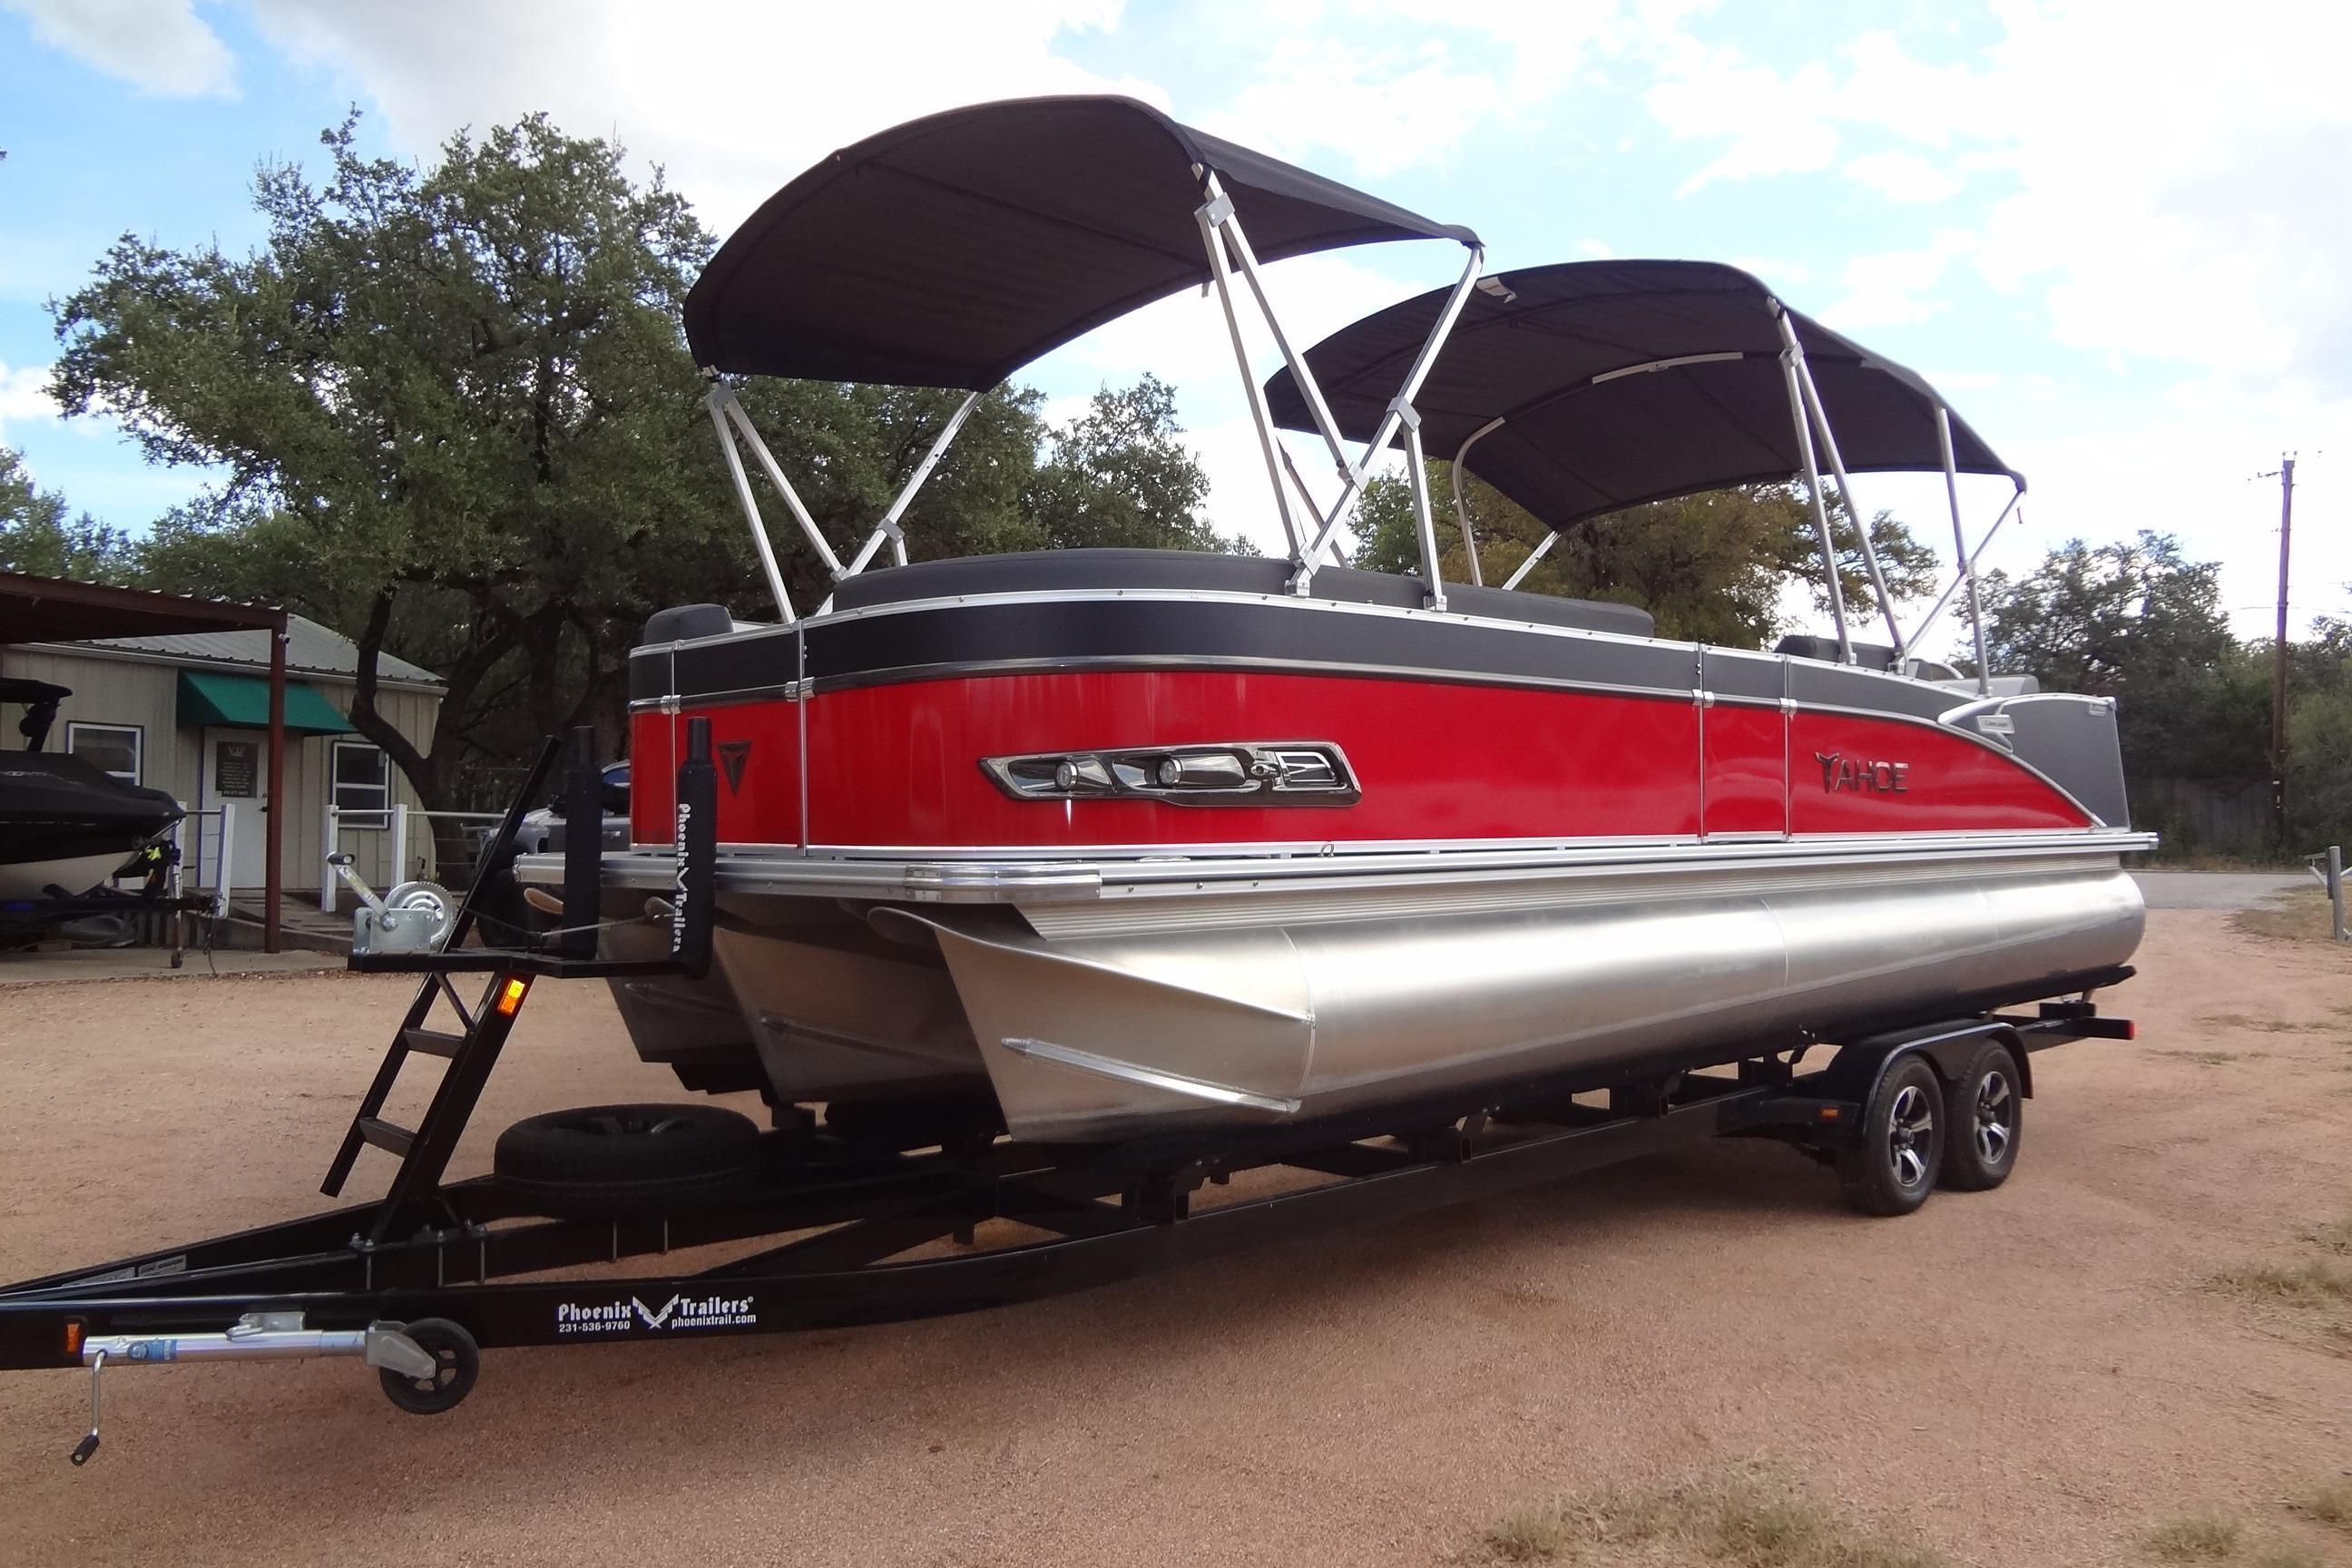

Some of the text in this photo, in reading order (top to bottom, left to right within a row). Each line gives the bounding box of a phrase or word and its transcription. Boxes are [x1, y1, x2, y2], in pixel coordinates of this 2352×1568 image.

[672, 803, 691, 953] Phoenix Trailers
[558, 1301, 632, 1321] Phoenix
[559, 1321, 631, 1333] 231-536-9760
[671, 1314, 757, 1329] phoenixtrail.com
